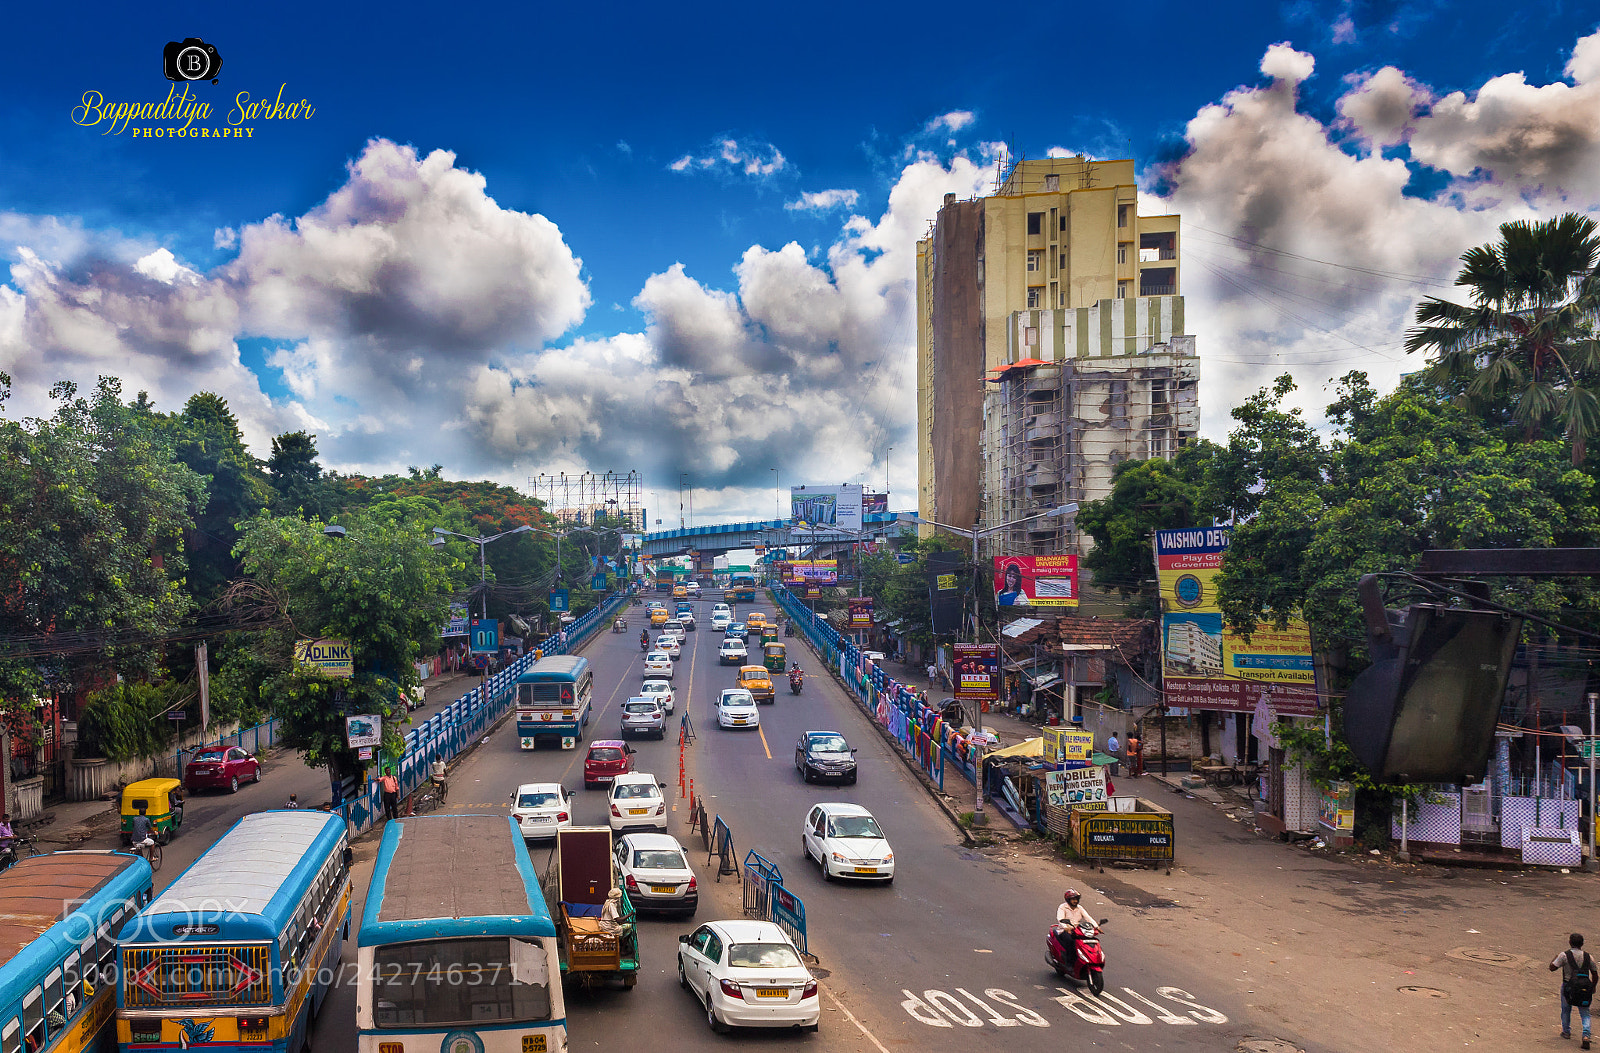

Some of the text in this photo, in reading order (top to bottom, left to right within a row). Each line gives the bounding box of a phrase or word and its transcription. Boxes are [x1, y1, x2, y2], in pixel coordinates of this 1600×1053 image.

[1160, 531, 1204, 549] VAISHNO
[1182, 555, 1203, 563] Play
[304, 645, 350, 661] ADLINK
[1239, 670, 1315, 681] Transport Available
[1055, 770, 1096, 783] MOBILE
[1049, 779, 1104, 792] REPARING CENTER
[901, 988, 1050, 1028] STOP
[1052, 987, 1229, 1027] STOP
[379, 1044, 404, 1053] STOP
